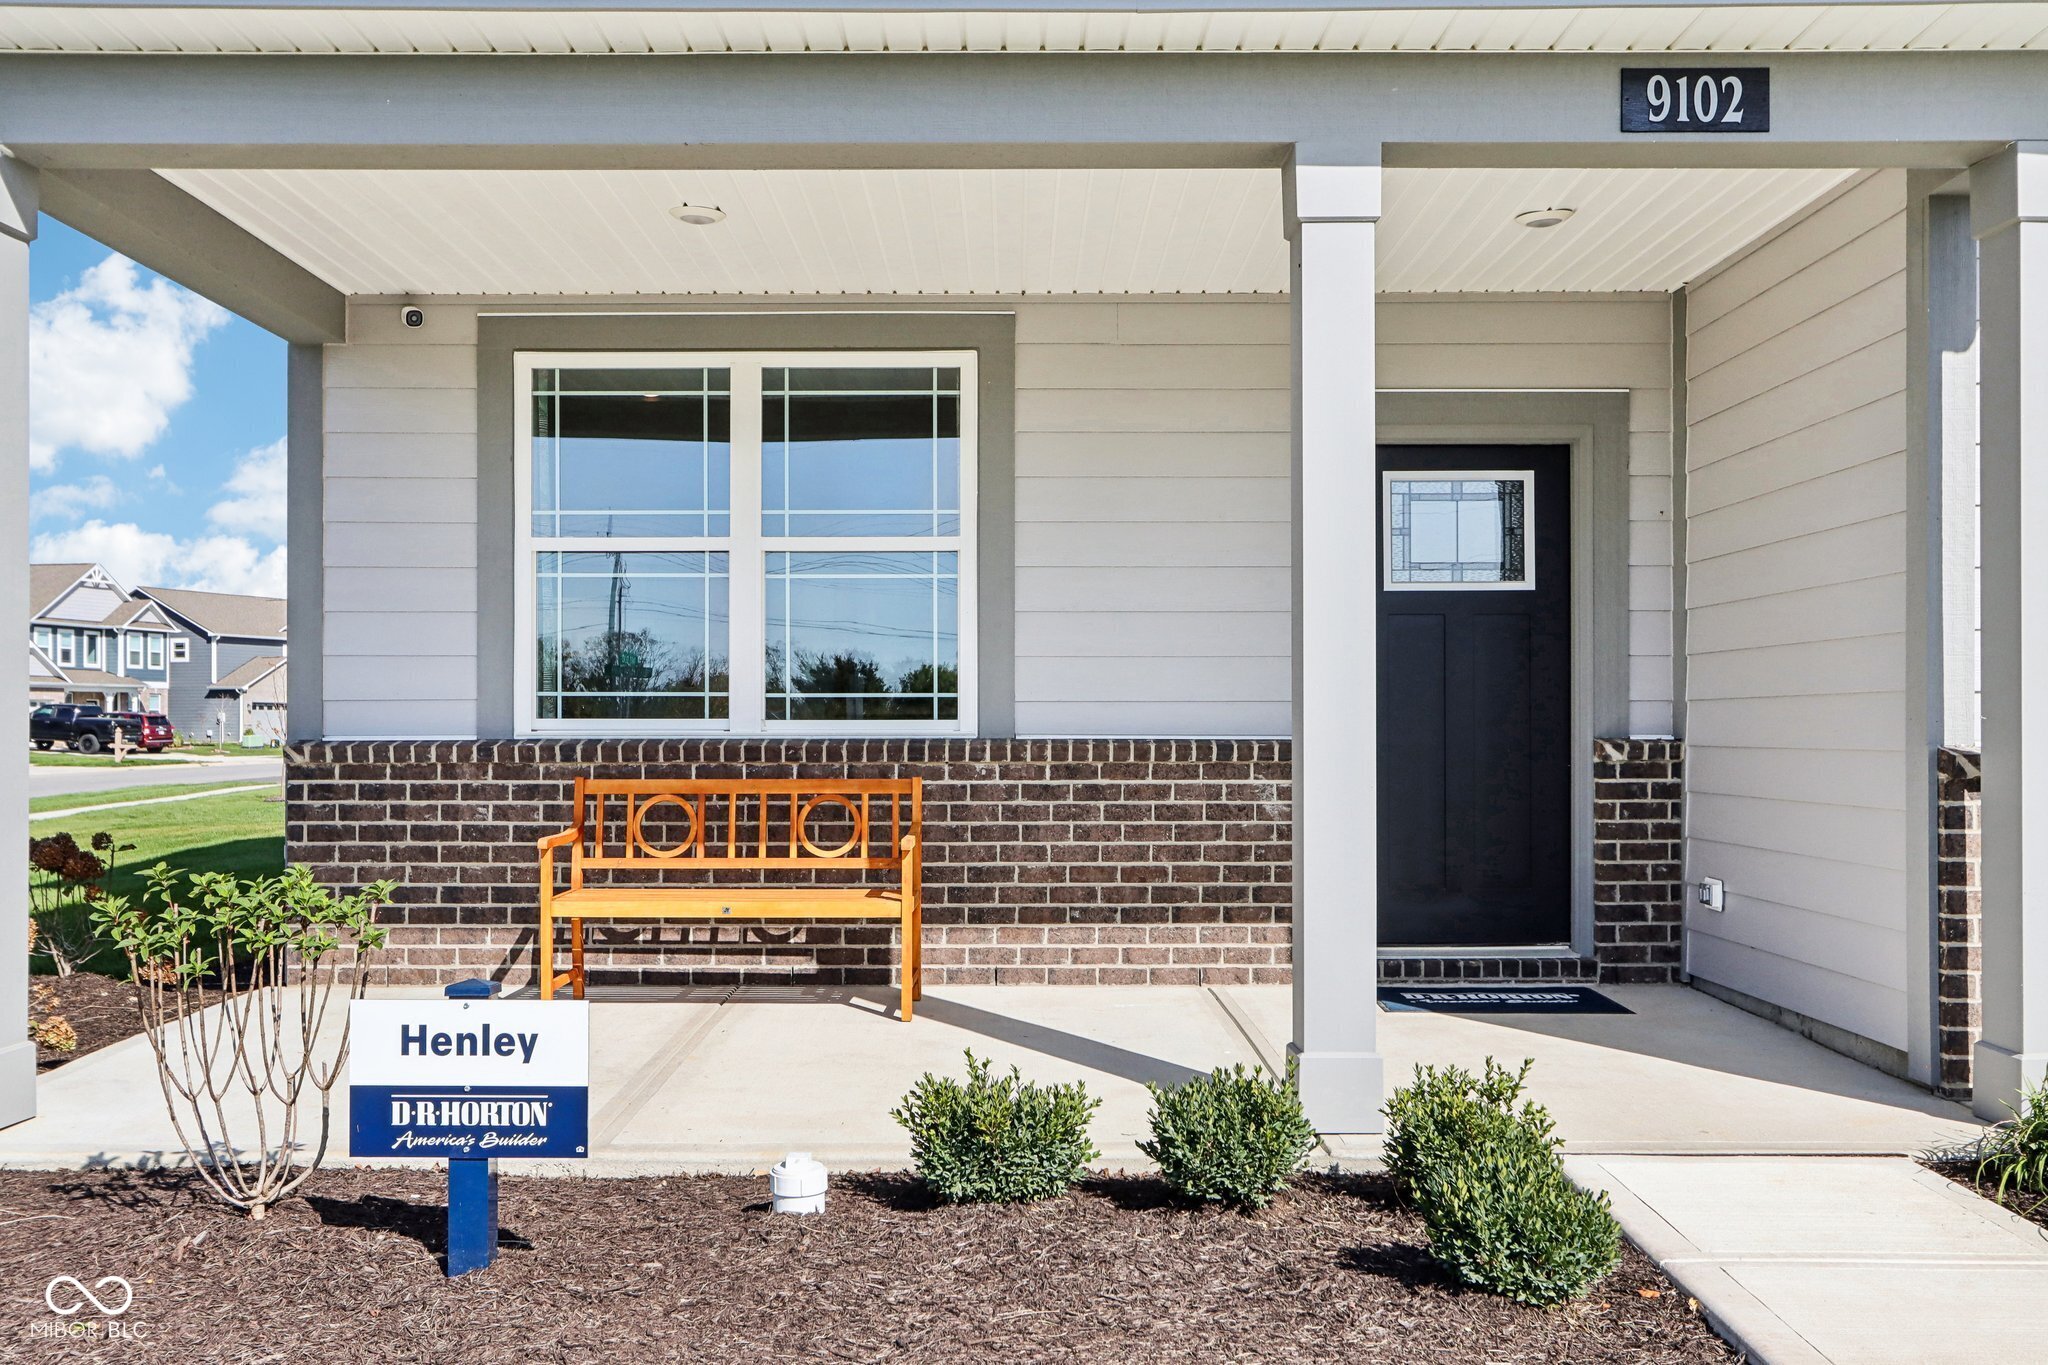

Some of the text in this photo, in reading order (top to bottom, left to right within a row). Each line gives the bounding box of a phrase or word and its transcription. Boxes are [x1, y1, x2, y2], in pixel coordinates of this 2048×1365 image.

[1646, 74, 1744, 124] 9102
[400, 1023, 539, 1064] Henley
[391, 1130, 548, 1150] America's Builder
